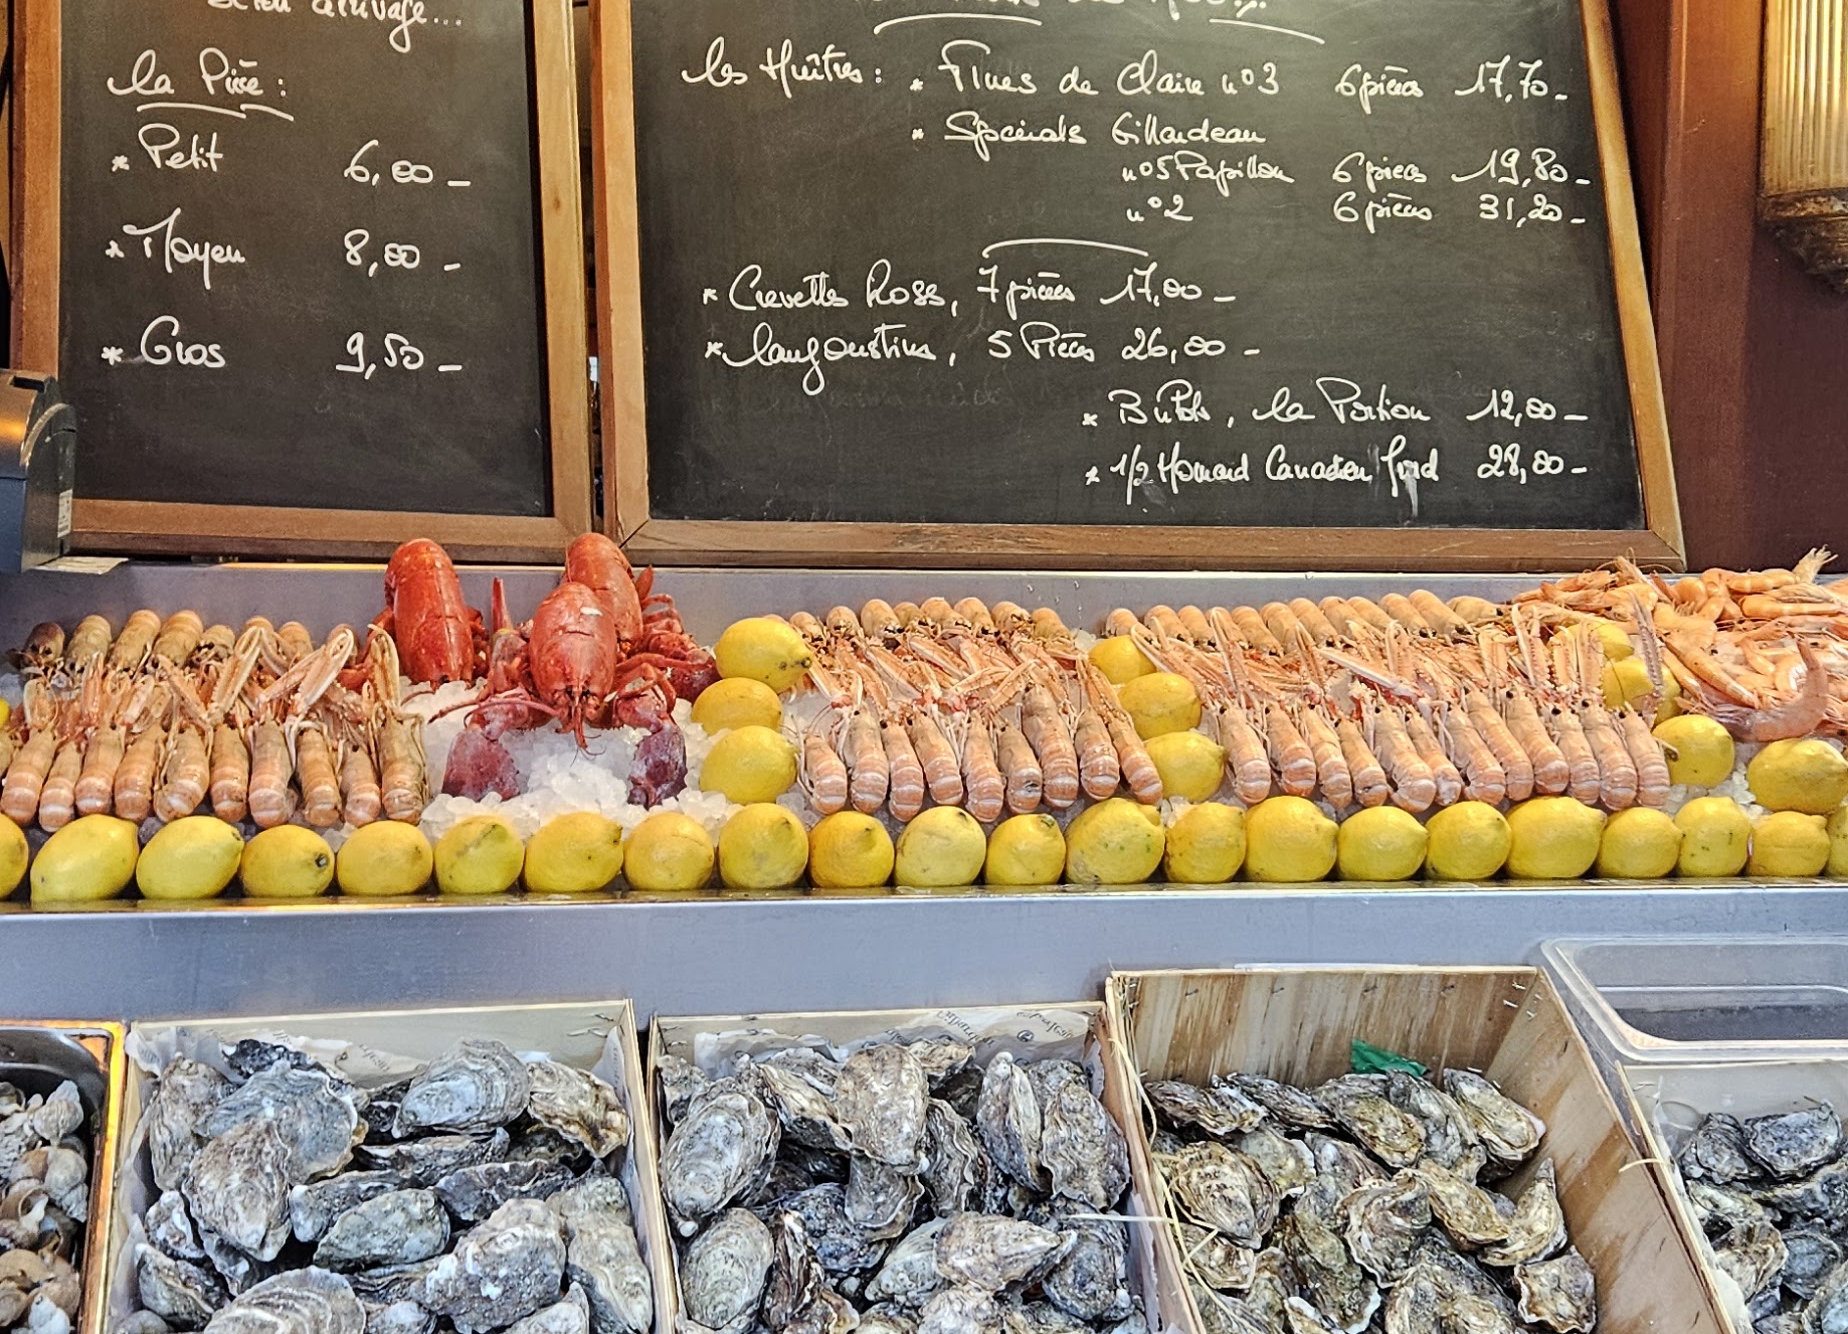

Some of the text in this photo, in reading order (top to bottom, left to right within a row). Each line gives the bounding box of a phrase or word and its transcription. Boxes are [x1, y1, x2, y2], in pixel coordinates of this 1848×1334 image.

[938, 39, 1038, 94] Fines
[1058, 65, 1099, 95] de
[1116, 49, 1205, 95] Claire
[138, 123, 223, 172] Petit
[1111, 111, 1267, 146] Gillardeau
[122, 207, 246, 290] Moyen
[140, 315, 226, 367] Gros
[987, 330, 1013, 359] 5
[1316, 377, 1431, 424] Portion
[1110, 444, 1152, 505] 1/2
[1157, 441, 1250, 495] Homard
